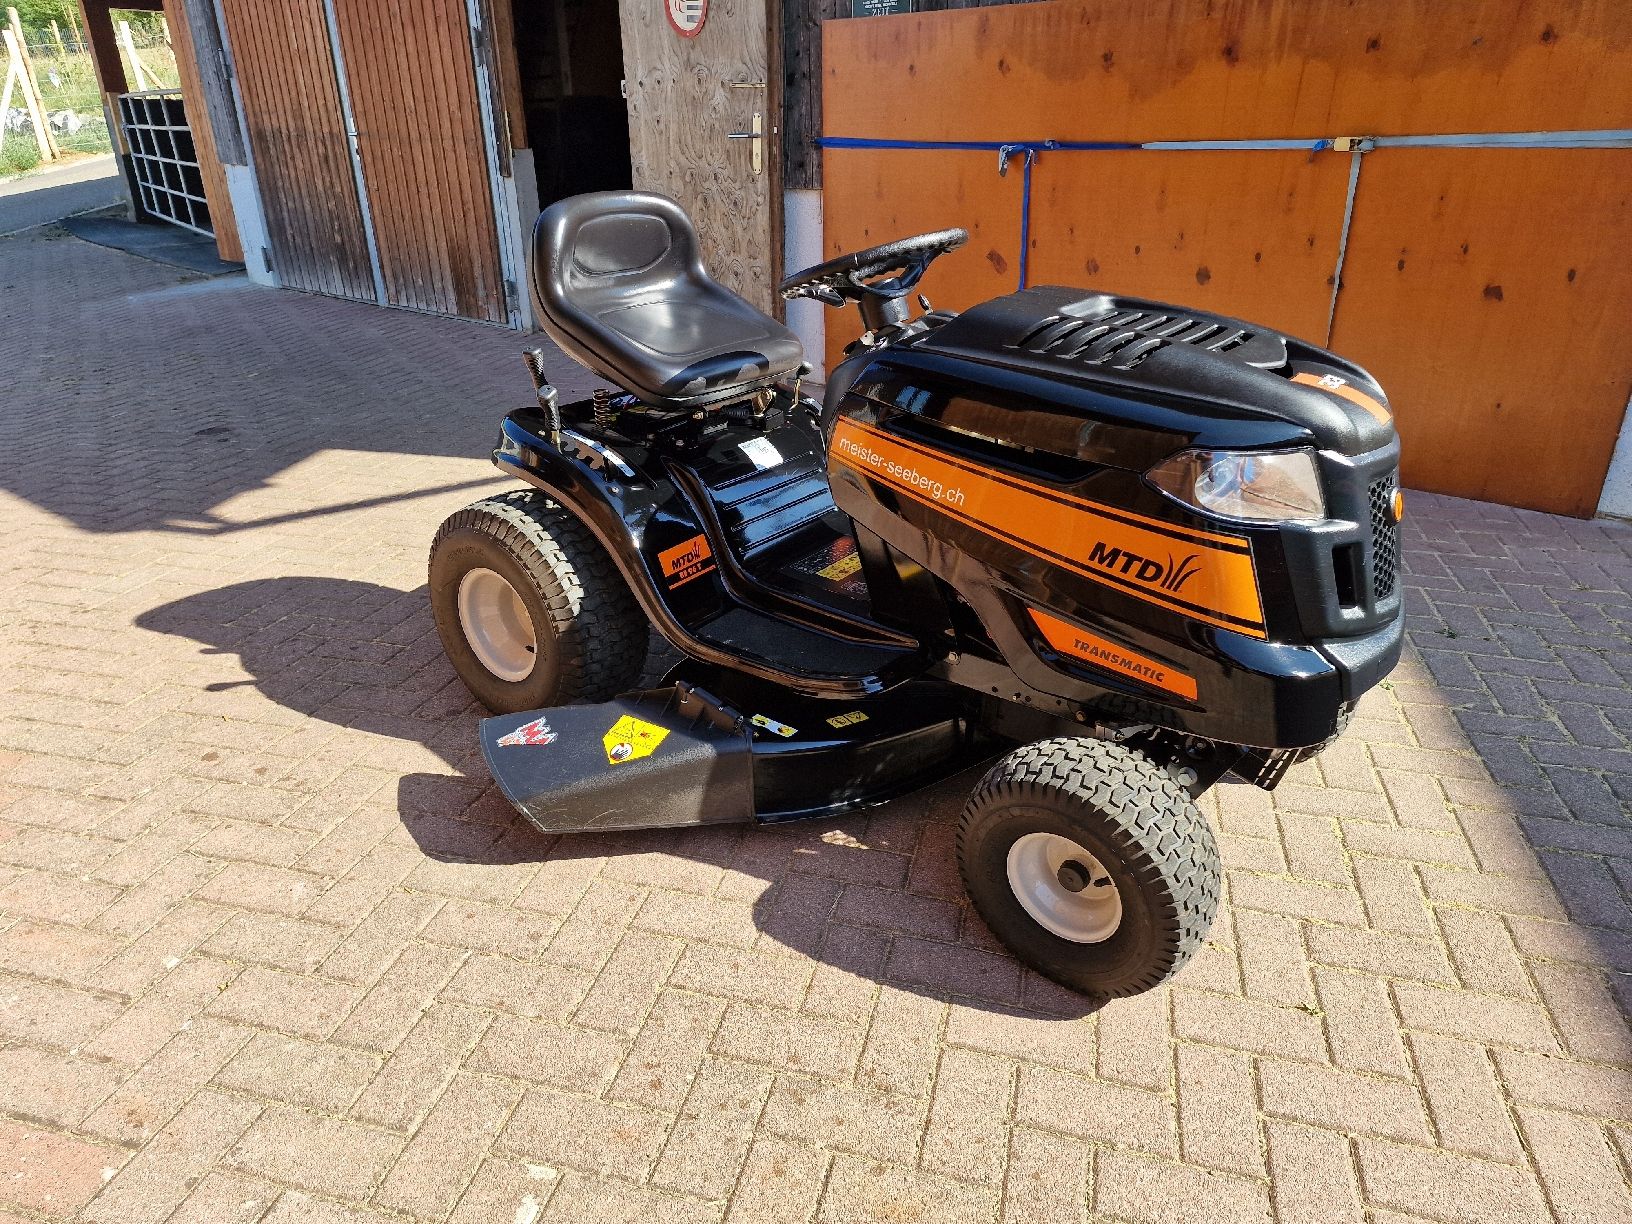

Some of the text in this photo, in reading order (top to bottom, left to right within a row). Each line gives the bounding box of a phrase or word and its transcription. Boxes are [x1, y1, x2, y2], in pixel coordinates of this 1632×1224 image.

[839, 436, 966, 507] meister-seeberg.ch
[1088, 541, 1164, 583] MTD
[1073, 638, 1166, 683] TRANSMATIC
